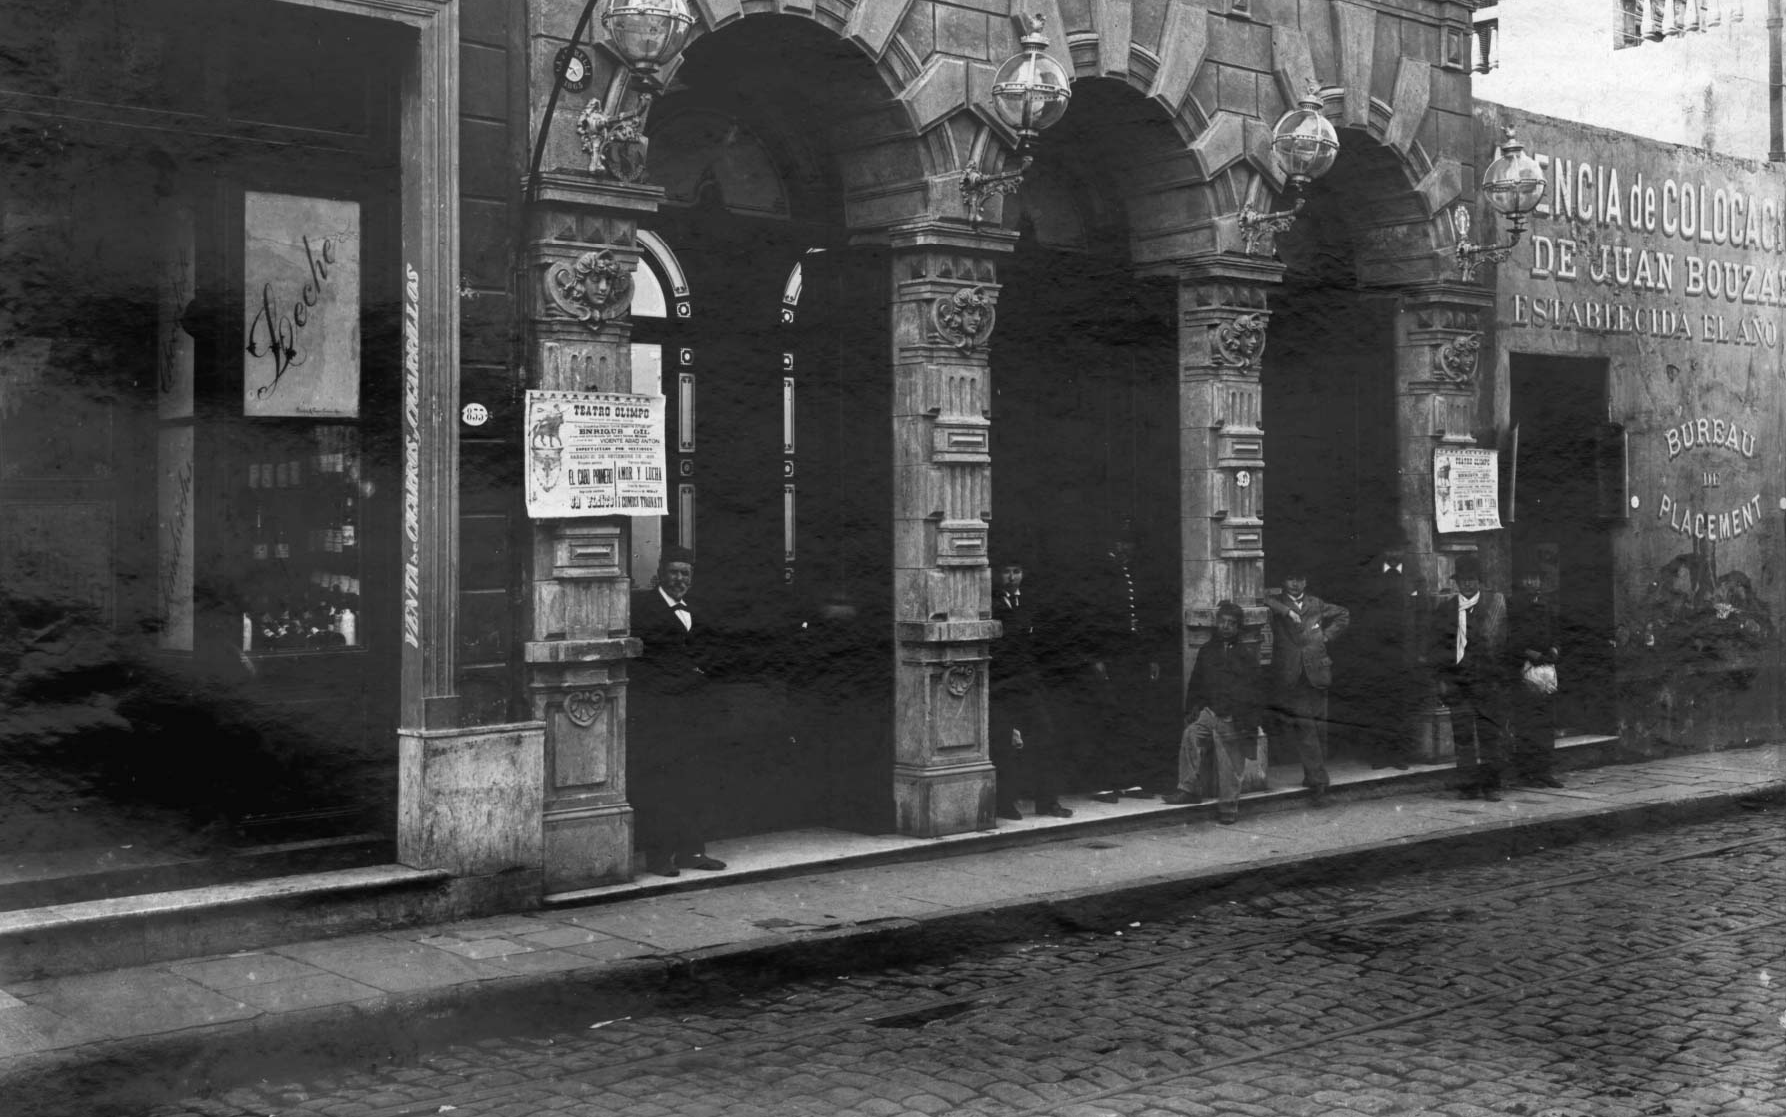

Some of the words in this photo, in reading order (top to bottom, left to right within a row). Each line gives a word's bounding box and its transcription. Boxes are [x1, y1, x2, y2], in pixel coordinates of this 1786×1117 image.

[1630, 173, 1655, 231] de
[1531, 235, 1577, 279] DE
[1590, 244, 1674, 292] JUAN
[246, 220, 350, 400] Leche
[1512, 294, 1692, 337] ESTABLECIDA
[1703, 314, 1730, 341] EL
[405, 262, 420, 430] CIGARRILLOS
[574, 405, 610, 417] TEATRO
[615, 407, 649, 419] OLIMPO
[1664, 418, 1755, 459] BUREAU
[405, 434, 420, 543] CIGARROS
[617, 467, 632, 480] AMOR
[645, 467, 662, 481] LUCHA
[1702, 472, 1720, 487] DE
[1658, 494, 1761, 540] PLACEMENT
[405, 563, 419, 650] VENTA
